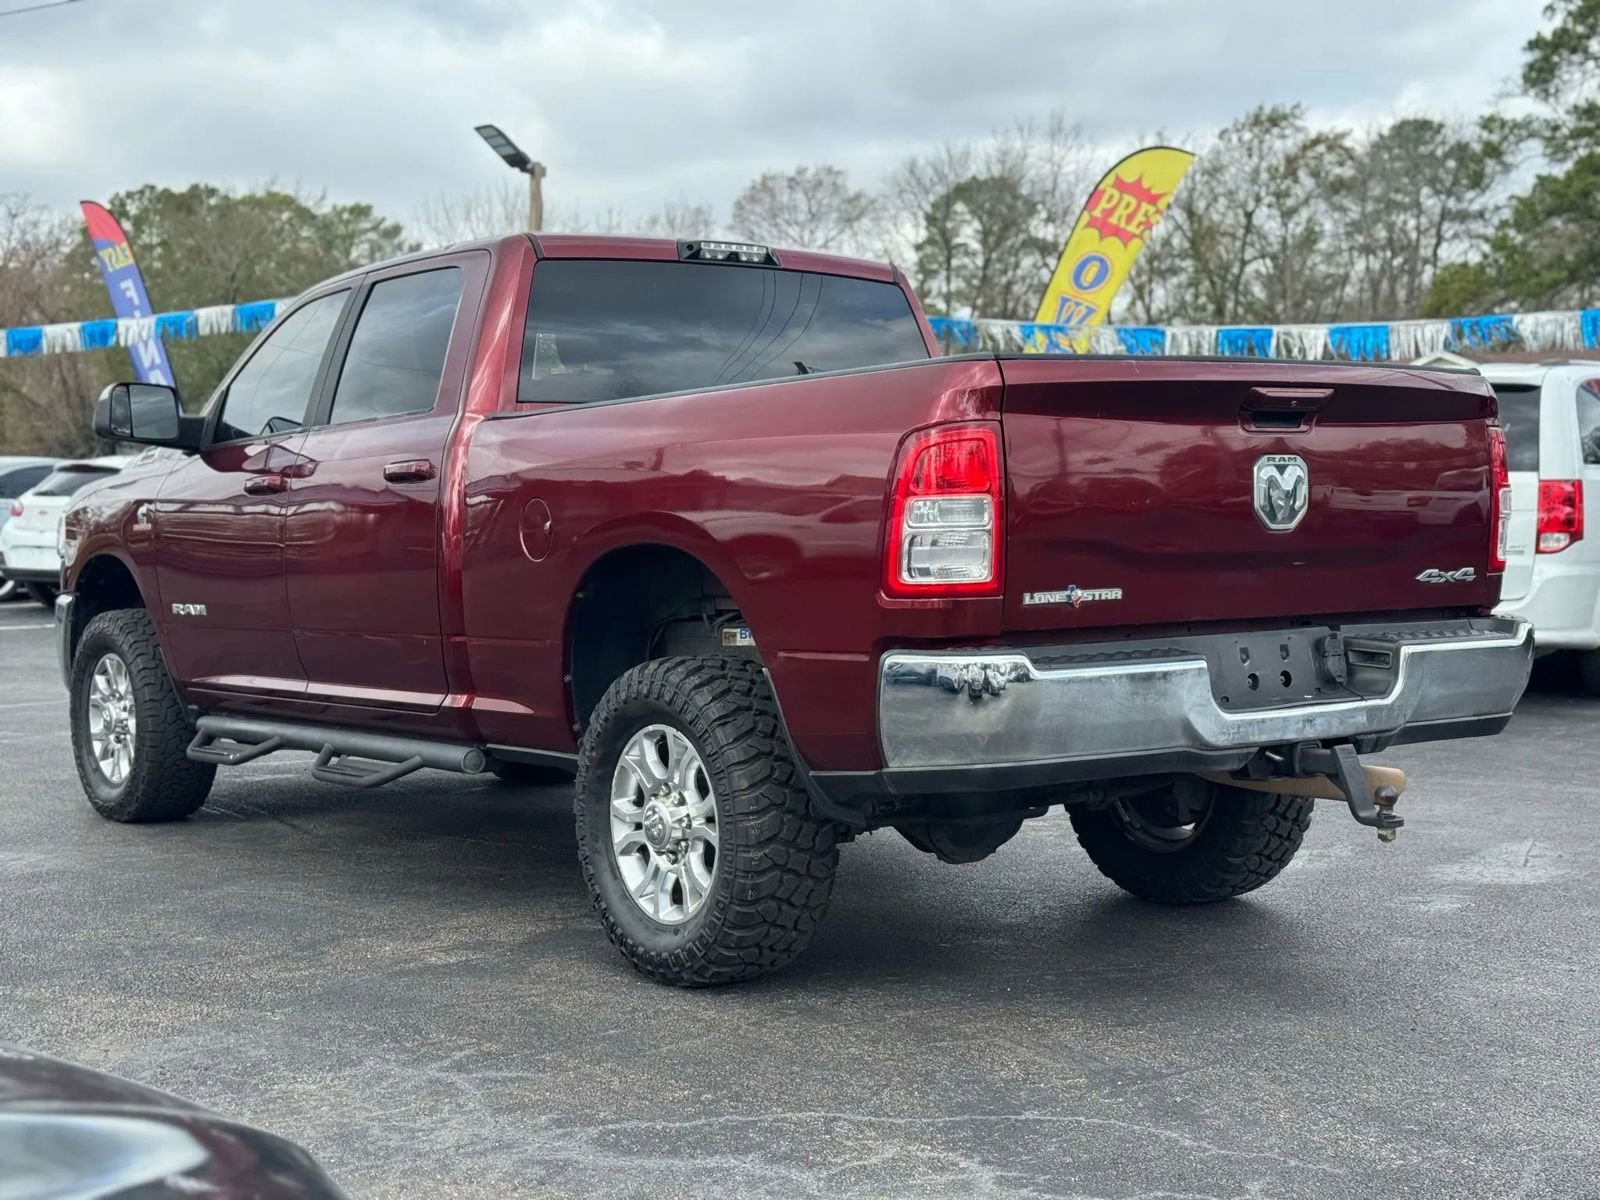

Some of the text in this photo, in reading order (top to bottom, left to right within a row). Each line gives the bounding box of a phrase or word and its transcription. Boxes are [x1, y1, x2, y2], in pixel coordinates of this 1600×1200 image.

[1023, 588, 1123, 605] LONE STAR
[171, 603, 207, 616] RAM
